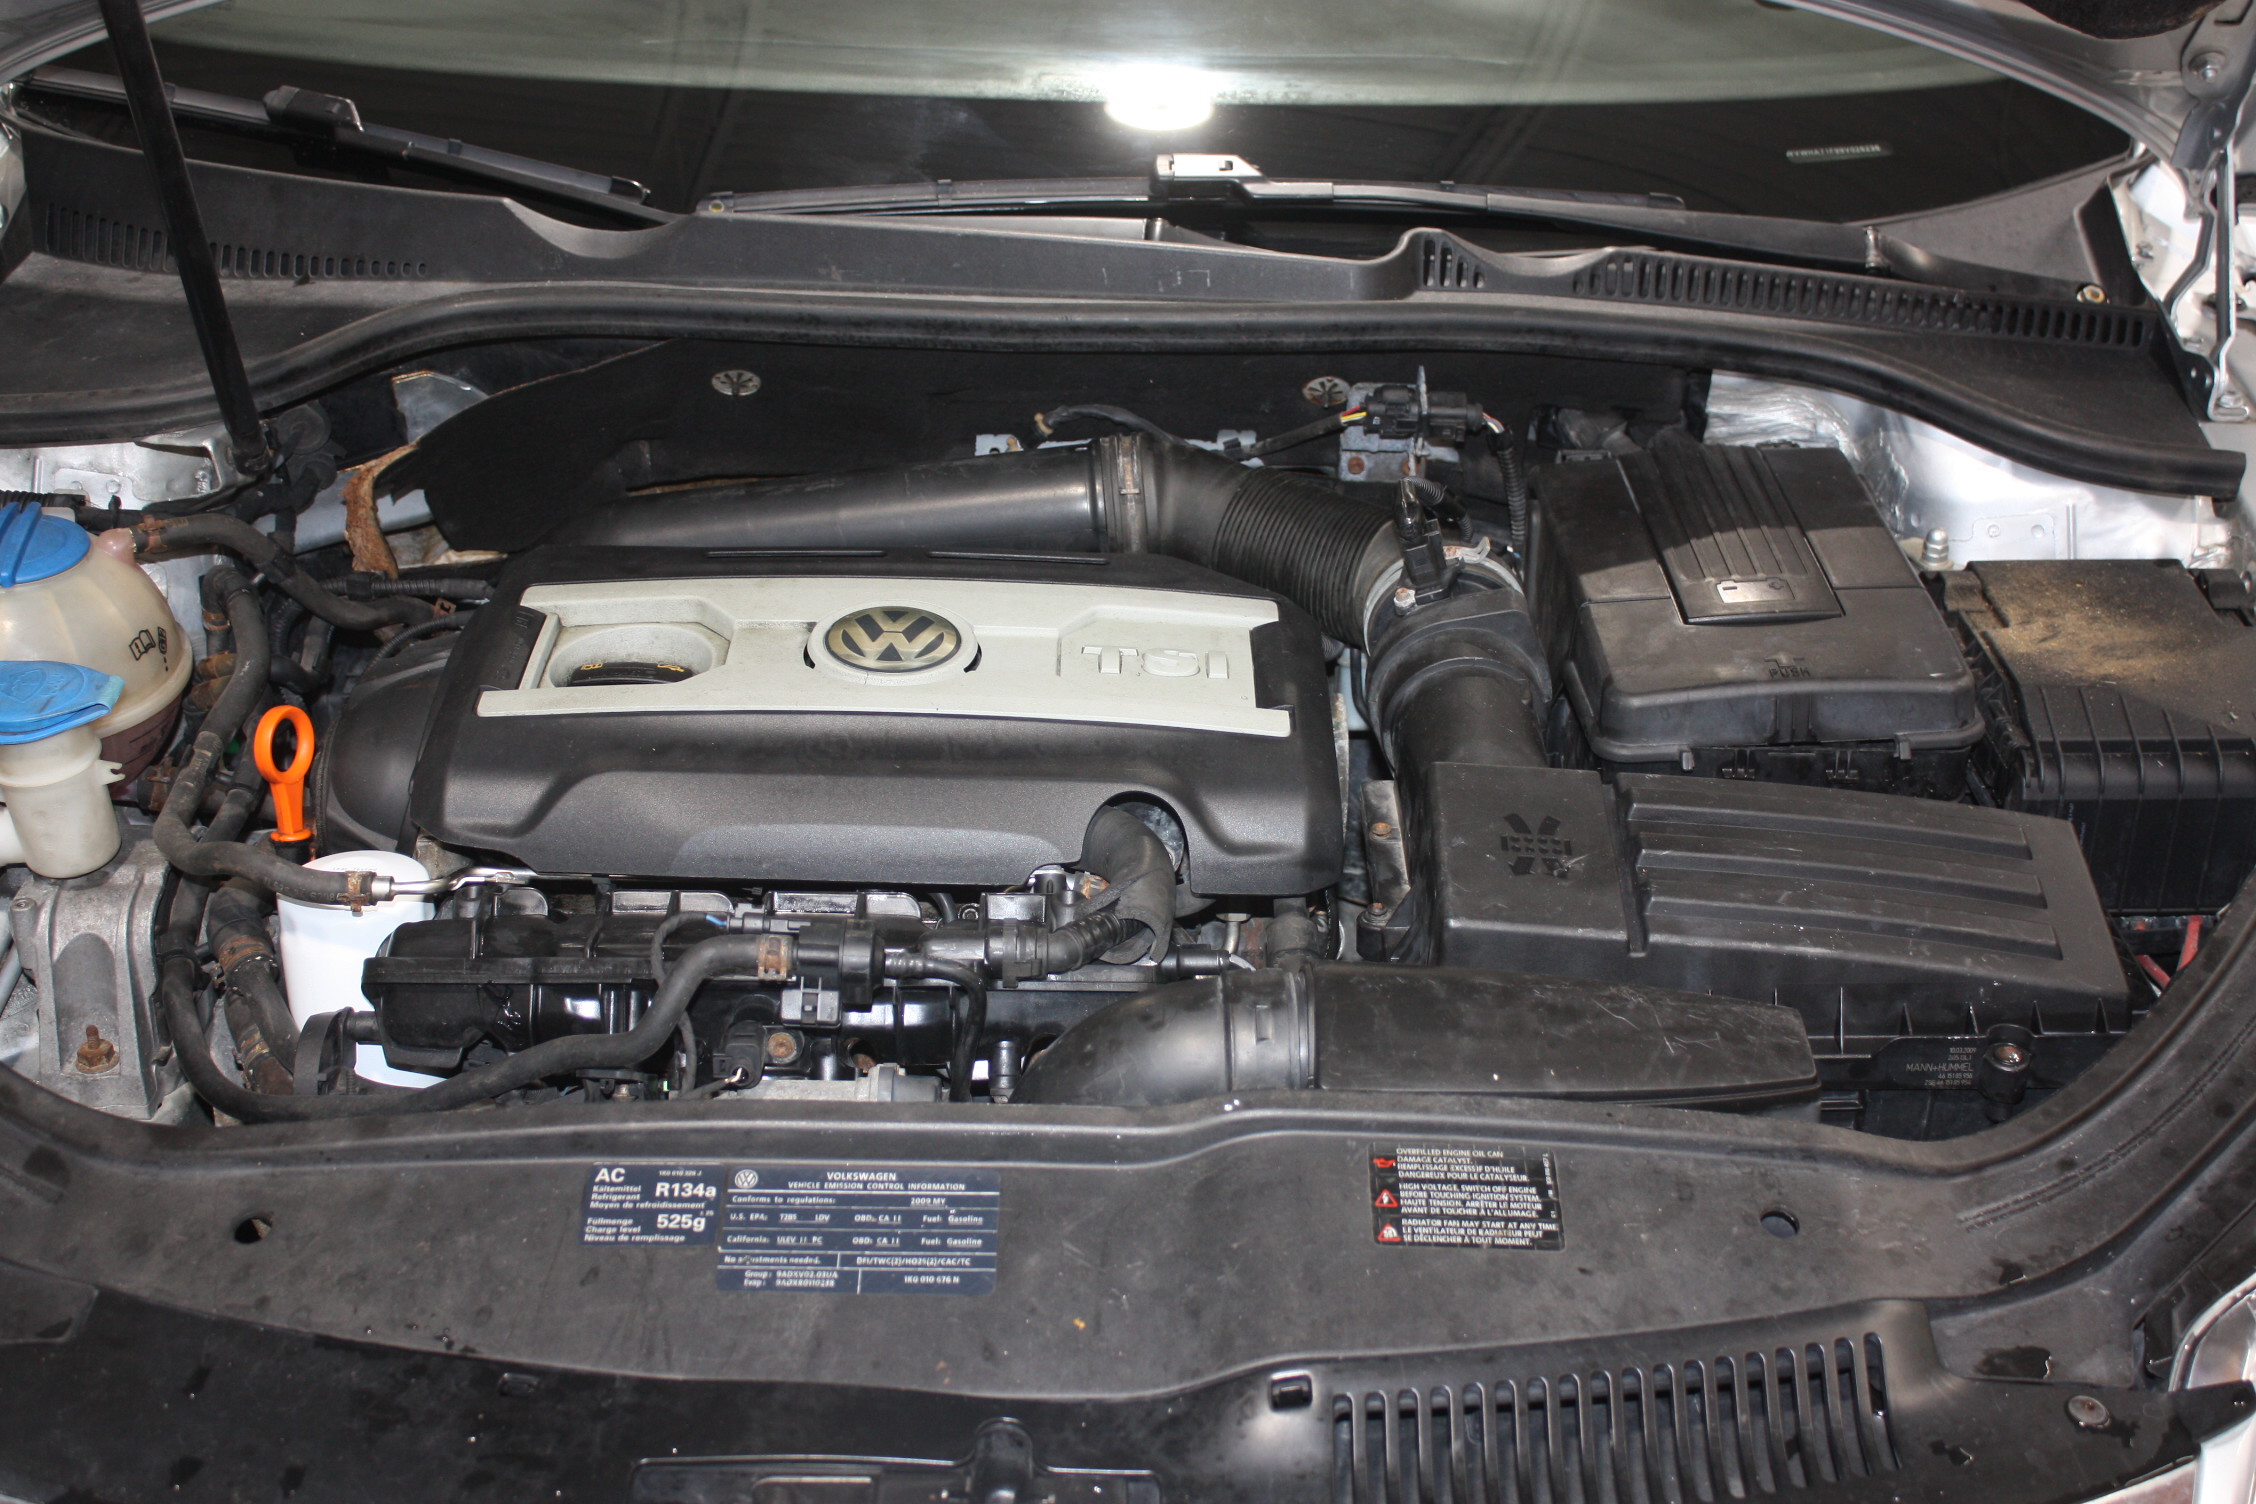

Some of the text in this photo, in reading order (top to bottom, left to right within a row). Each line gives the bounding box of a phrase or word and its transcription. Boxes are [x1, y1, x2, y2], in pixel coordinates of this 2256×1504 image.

[1081, 645, 1230, 680] TSI
[1768, 665, 1811, 679] PUSH
[1905, 1062, 1974, 1072] MANN+HUMMEL
[1396, 1148, 1441, 1156] OVERFILLED
[1472, 1150, 1486, 1158] OIL
[1487, 1150, 1504, 1158] CAN
[1397, 1155, 1473, 1165] DAMAGE CATALYST.
[595, 1167, 626, 1183] AC
[826, 1172, 897, 1181] VOLKSWAGEN
[1398, 1171, 1445, 1179] DANGEREUX
[1447, 1172, 1468, 1180] POUR
[1479, 1173, 1530, 1182] CATALYSEUR.
[592, 1185, 642, 1193] Kältemittel
[655, 1182, 717, 1198] R134a
[788, 1181, 965, 1191] VEHICLE EMISSION CONTROL INFORMATION
[1461, 1184, 1491, 1192] SWITCH
[1508, 1186, 1537, 1194] ENGINE
[591, 1193, 641, 1202] Refrigerant
[732, 1195, 771, 1203] Conforms
[787, 1196, 836, 1205] regulations:
[1430, 1191, 1471, 1199] TOUCHING
[1509, 1194, 1542, 1202] SYSTEM.
[590, 1201, 706, 1210] Moyen de refroidissement
[910, 1197, 946, 1206] 2009 MY
[1510, 1202, 1542, 1210] MOTEUR
[1443, 1208, 1478, 1216] TOUCHER
[1479, 1208, 1486, 1216] À
[586, 1217, 634, 1226] Füllmenge
[730, 1213, 746, 1221] U.S.
[815, 1213, 830, 1222] LDV
[878, 1215, 890, 1223] CA
[948, 1215, 983, 1224] Gasoline
[657, 1213, 706, 1232] 525g
[1401, 1218, 1442, 1226] RADIATOR
[1443, 1219, 1460, 1227] FAN
[1519, 1222, 1536, 1230] ANY
[585, 1226, 617, 1235] Charge
[1402, 1226, 1412, 1234] LE
[1413, 1227, 1465, 1235] VENTILATEUR
[1478, 1229, 1522, 1237] RADIATEUR
[1524, 1230, 1544, 1238] PEUT
[584, 1234, 616, 1242] Niveau
[631, 1235, 686, 1244] remplissage
[727, 1235, 770, 1244] California:
[777, 1236, 797, 1244] ULEV
[812, 1236, 823, 1244] PC
[876, 1237, 888, 1245] CA
[921, 1238, 983, 1246] Fuel: Gasoline
[1463, 1235, 1470, 1243] À
[1472, 1236, 1492, 1244] TOUT
[1494, 1238, 1533, 1246] MOMENT.
[724, 1255, 736, 1263] No
[789, 1256, 821, 1264] needed.
